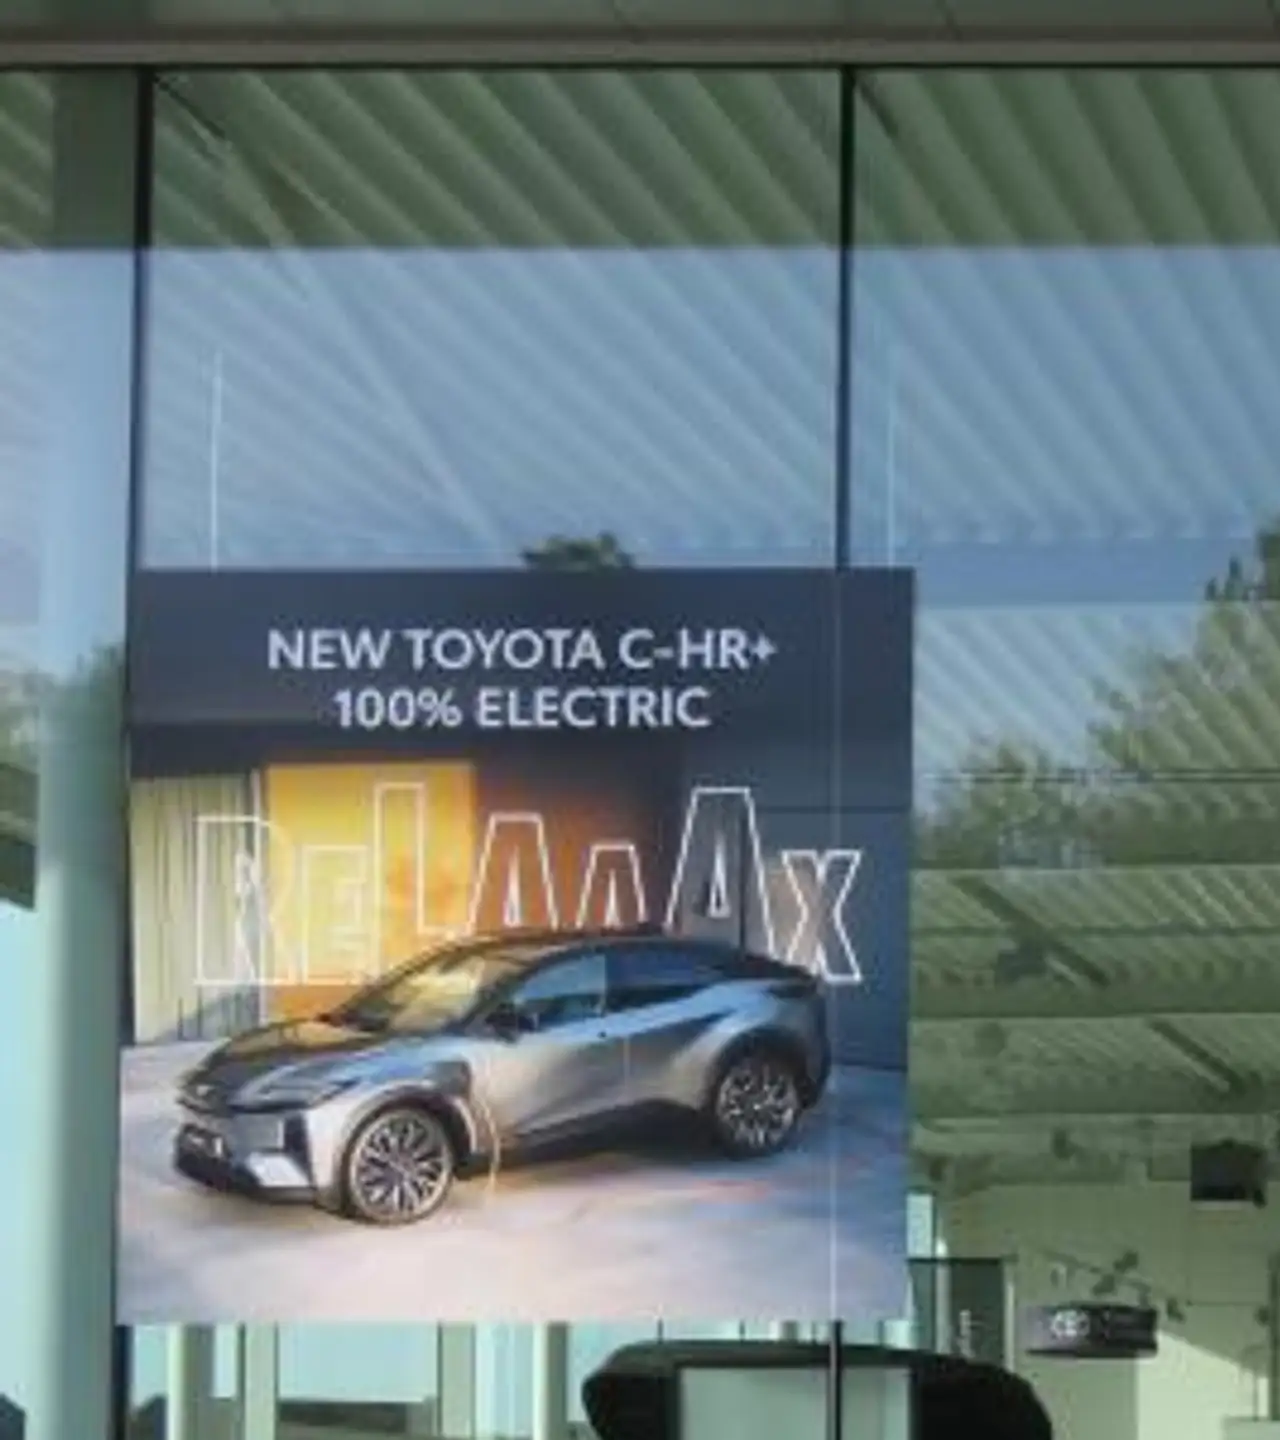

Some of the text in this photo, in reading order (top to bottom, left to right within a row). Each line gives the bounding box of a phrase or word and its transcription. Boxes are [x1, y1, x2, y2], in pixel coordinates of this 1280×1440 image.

[267, 628, 778, 670] NEW TOYOTA C-HR+
[333, 685, 712, 729] 100% ELECTRIC
